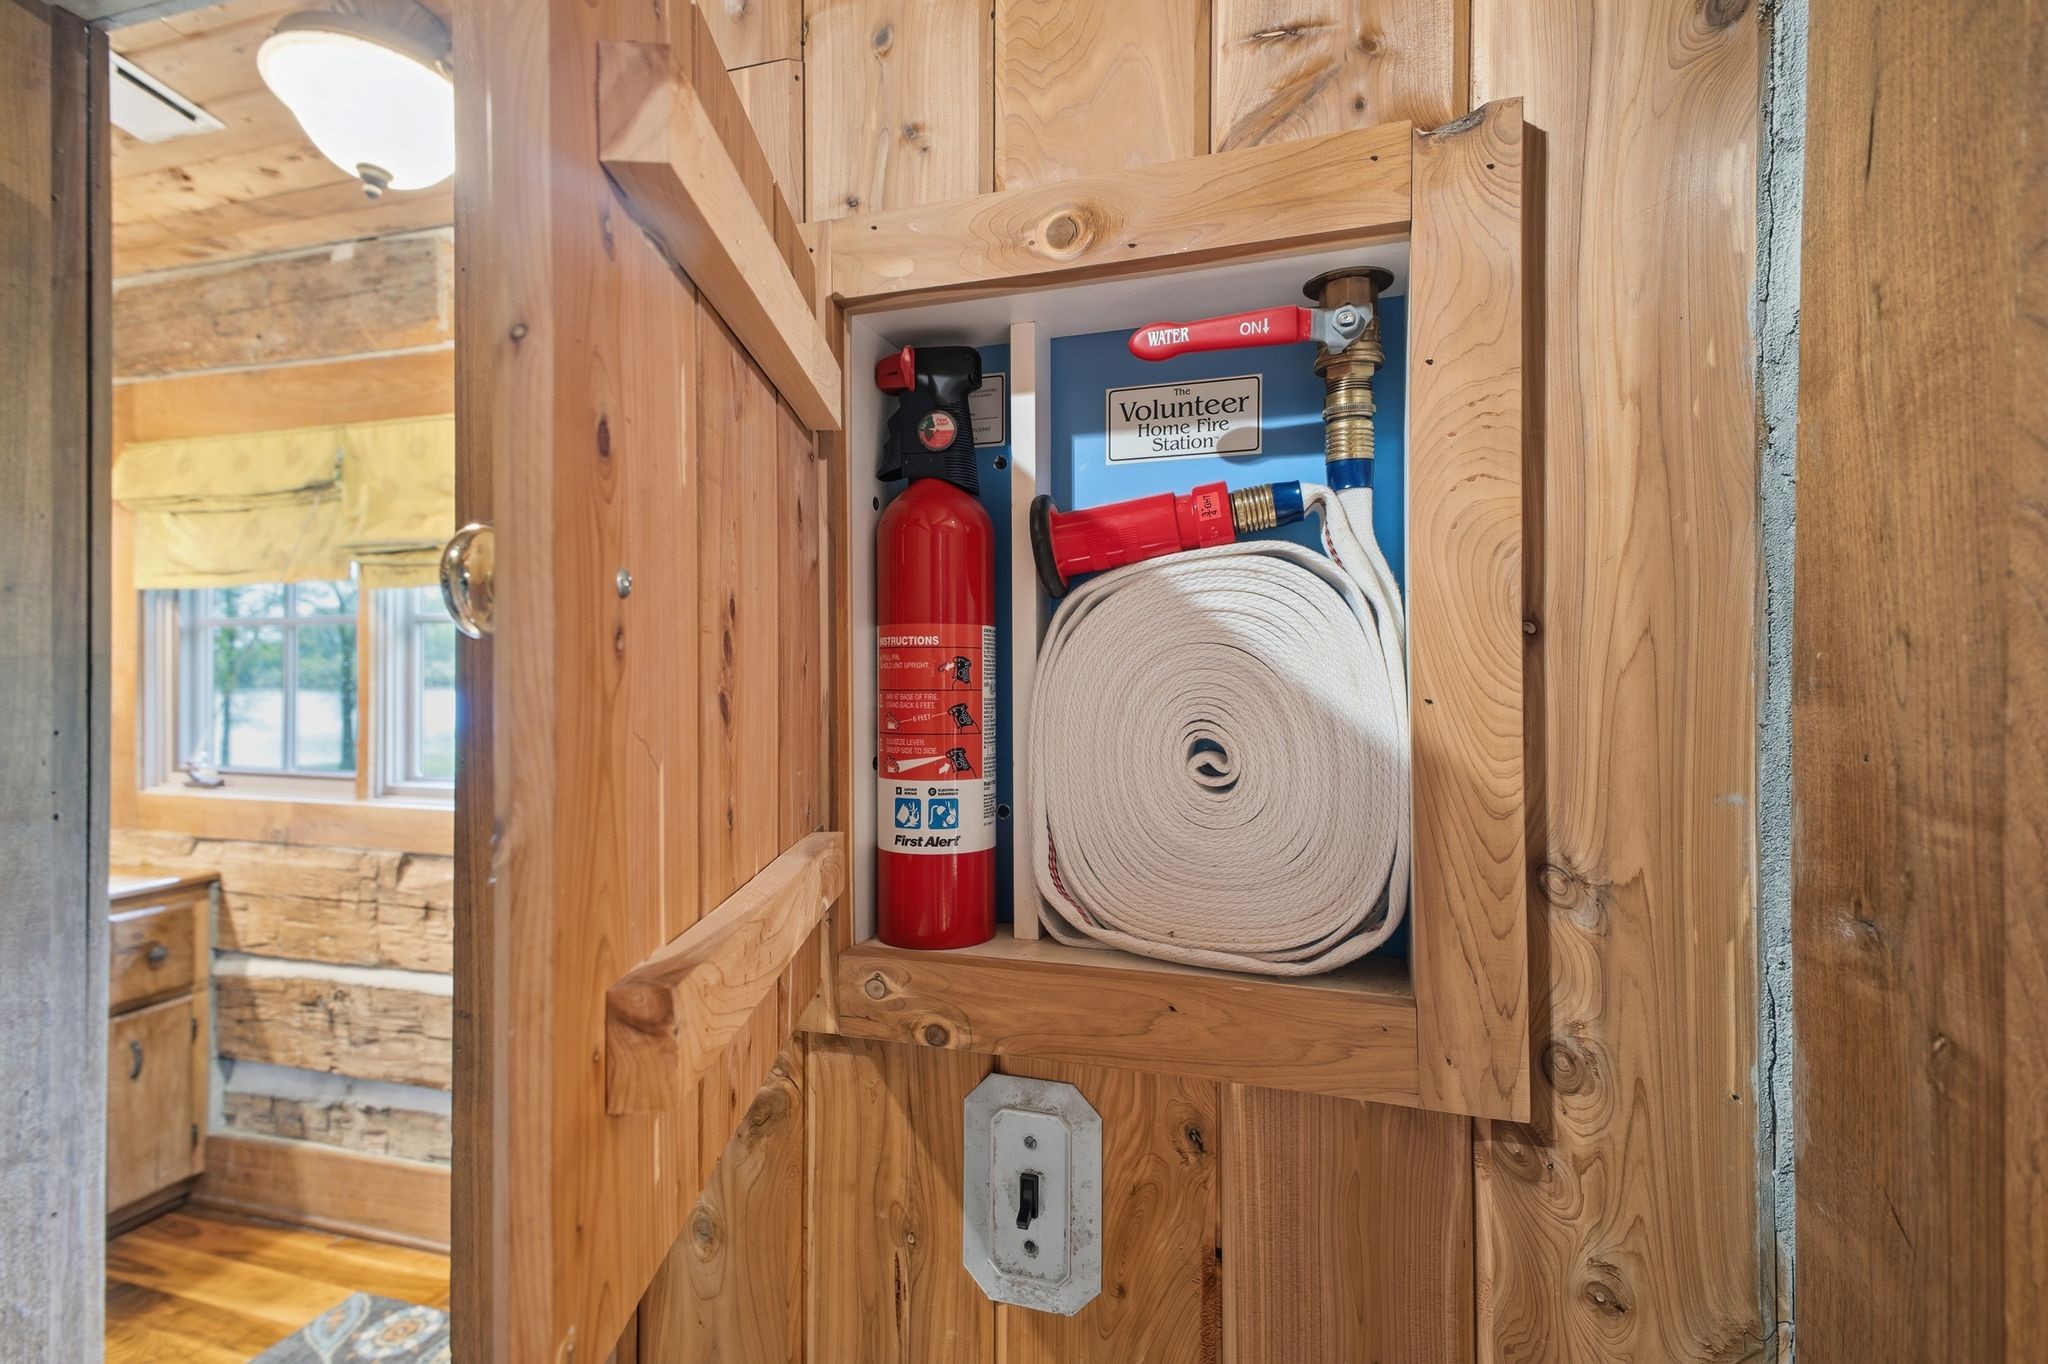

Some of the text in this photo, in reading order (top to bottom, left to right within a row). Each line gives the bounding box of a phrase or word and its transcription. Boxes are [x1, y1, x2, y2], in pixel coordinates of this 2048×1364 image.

[1147, 320, 1262, 347] WATER ON
[1173, 388, 1191, 396] The
[1119, 395, 1250, 422] Volunteer
[1137, 417, 1230, 438] Home Fire
[894, 835, 924, 847] First
